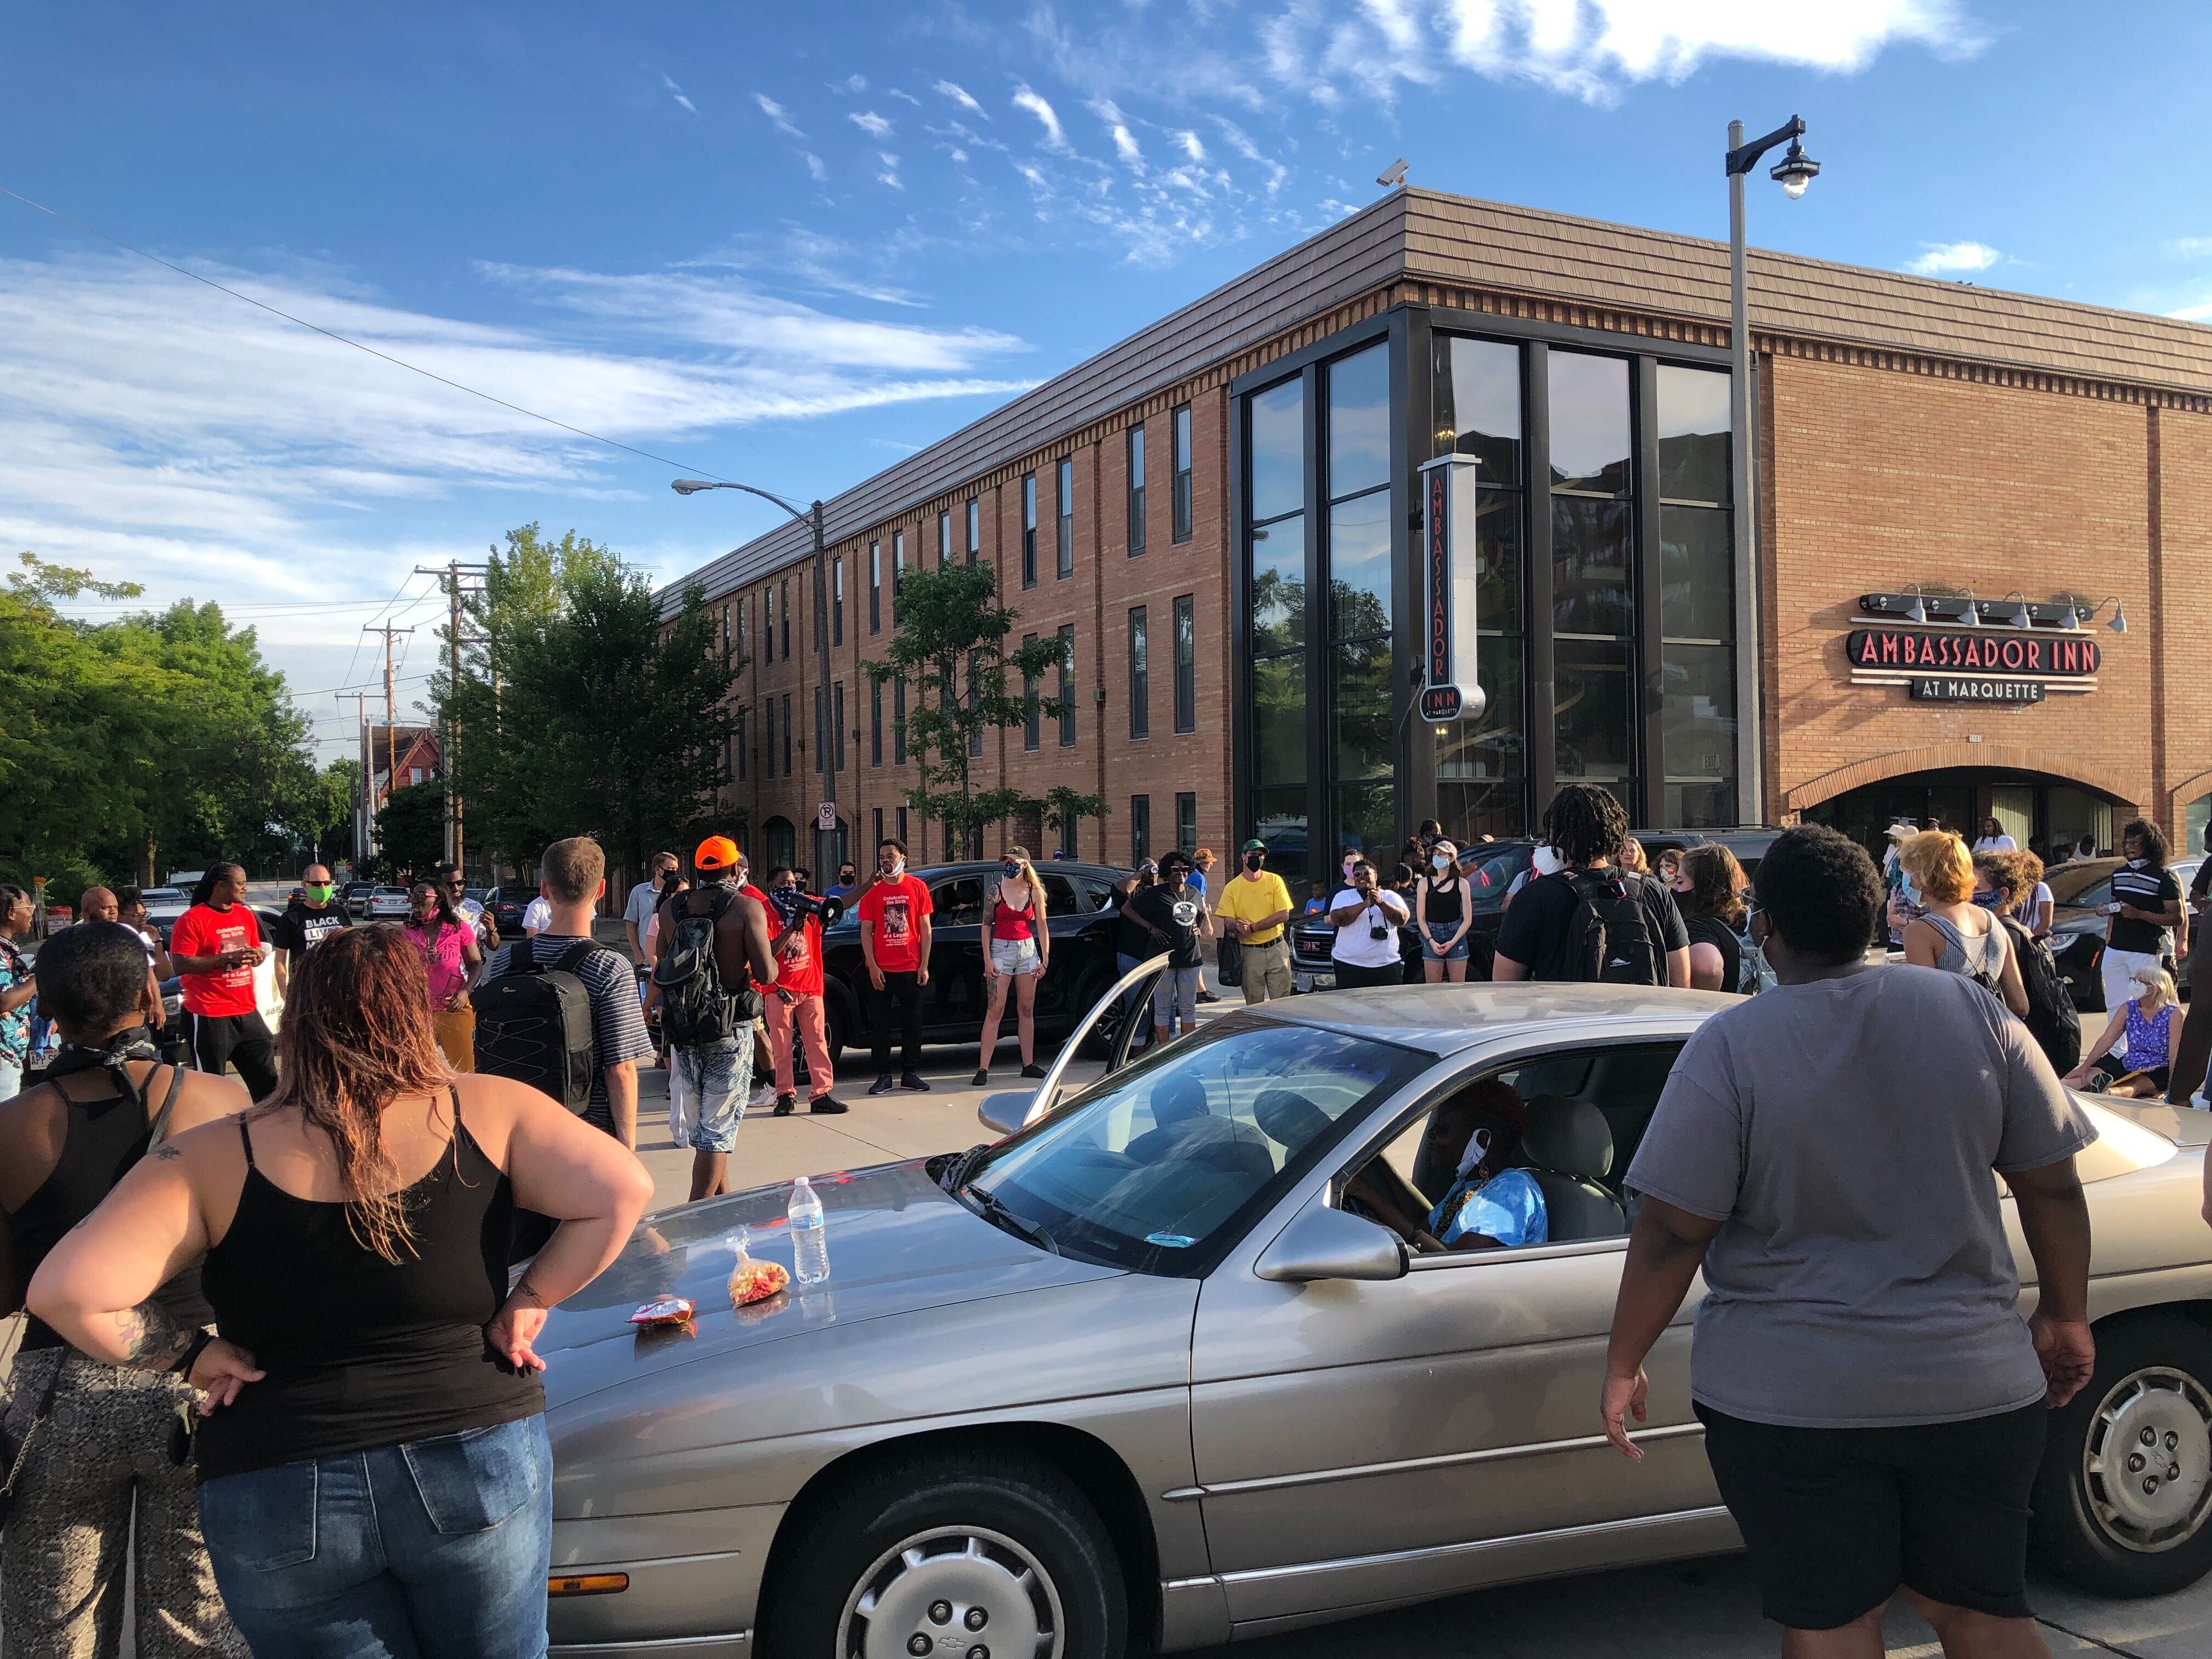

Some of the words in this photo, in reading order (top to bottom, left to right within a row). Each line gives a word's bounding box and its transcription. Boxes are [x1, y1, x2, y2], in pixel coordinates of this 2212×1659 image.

[1432, 478, 1446, 676] AMBASSADOR
[1861, 632, 2040, 669] AMBASSADOR
[2052, 640, 2095, 672] INN
[1922, 680, 1940, 696] AT
[1949, 680, 2038, 699] MARQUETTE
[1426, 691, 1454, 708] INN
[1705, 754, 1717, 768] EXIT
[305, 916, 340, 928] BLACK
[309, 928, 329, 938] LIV
